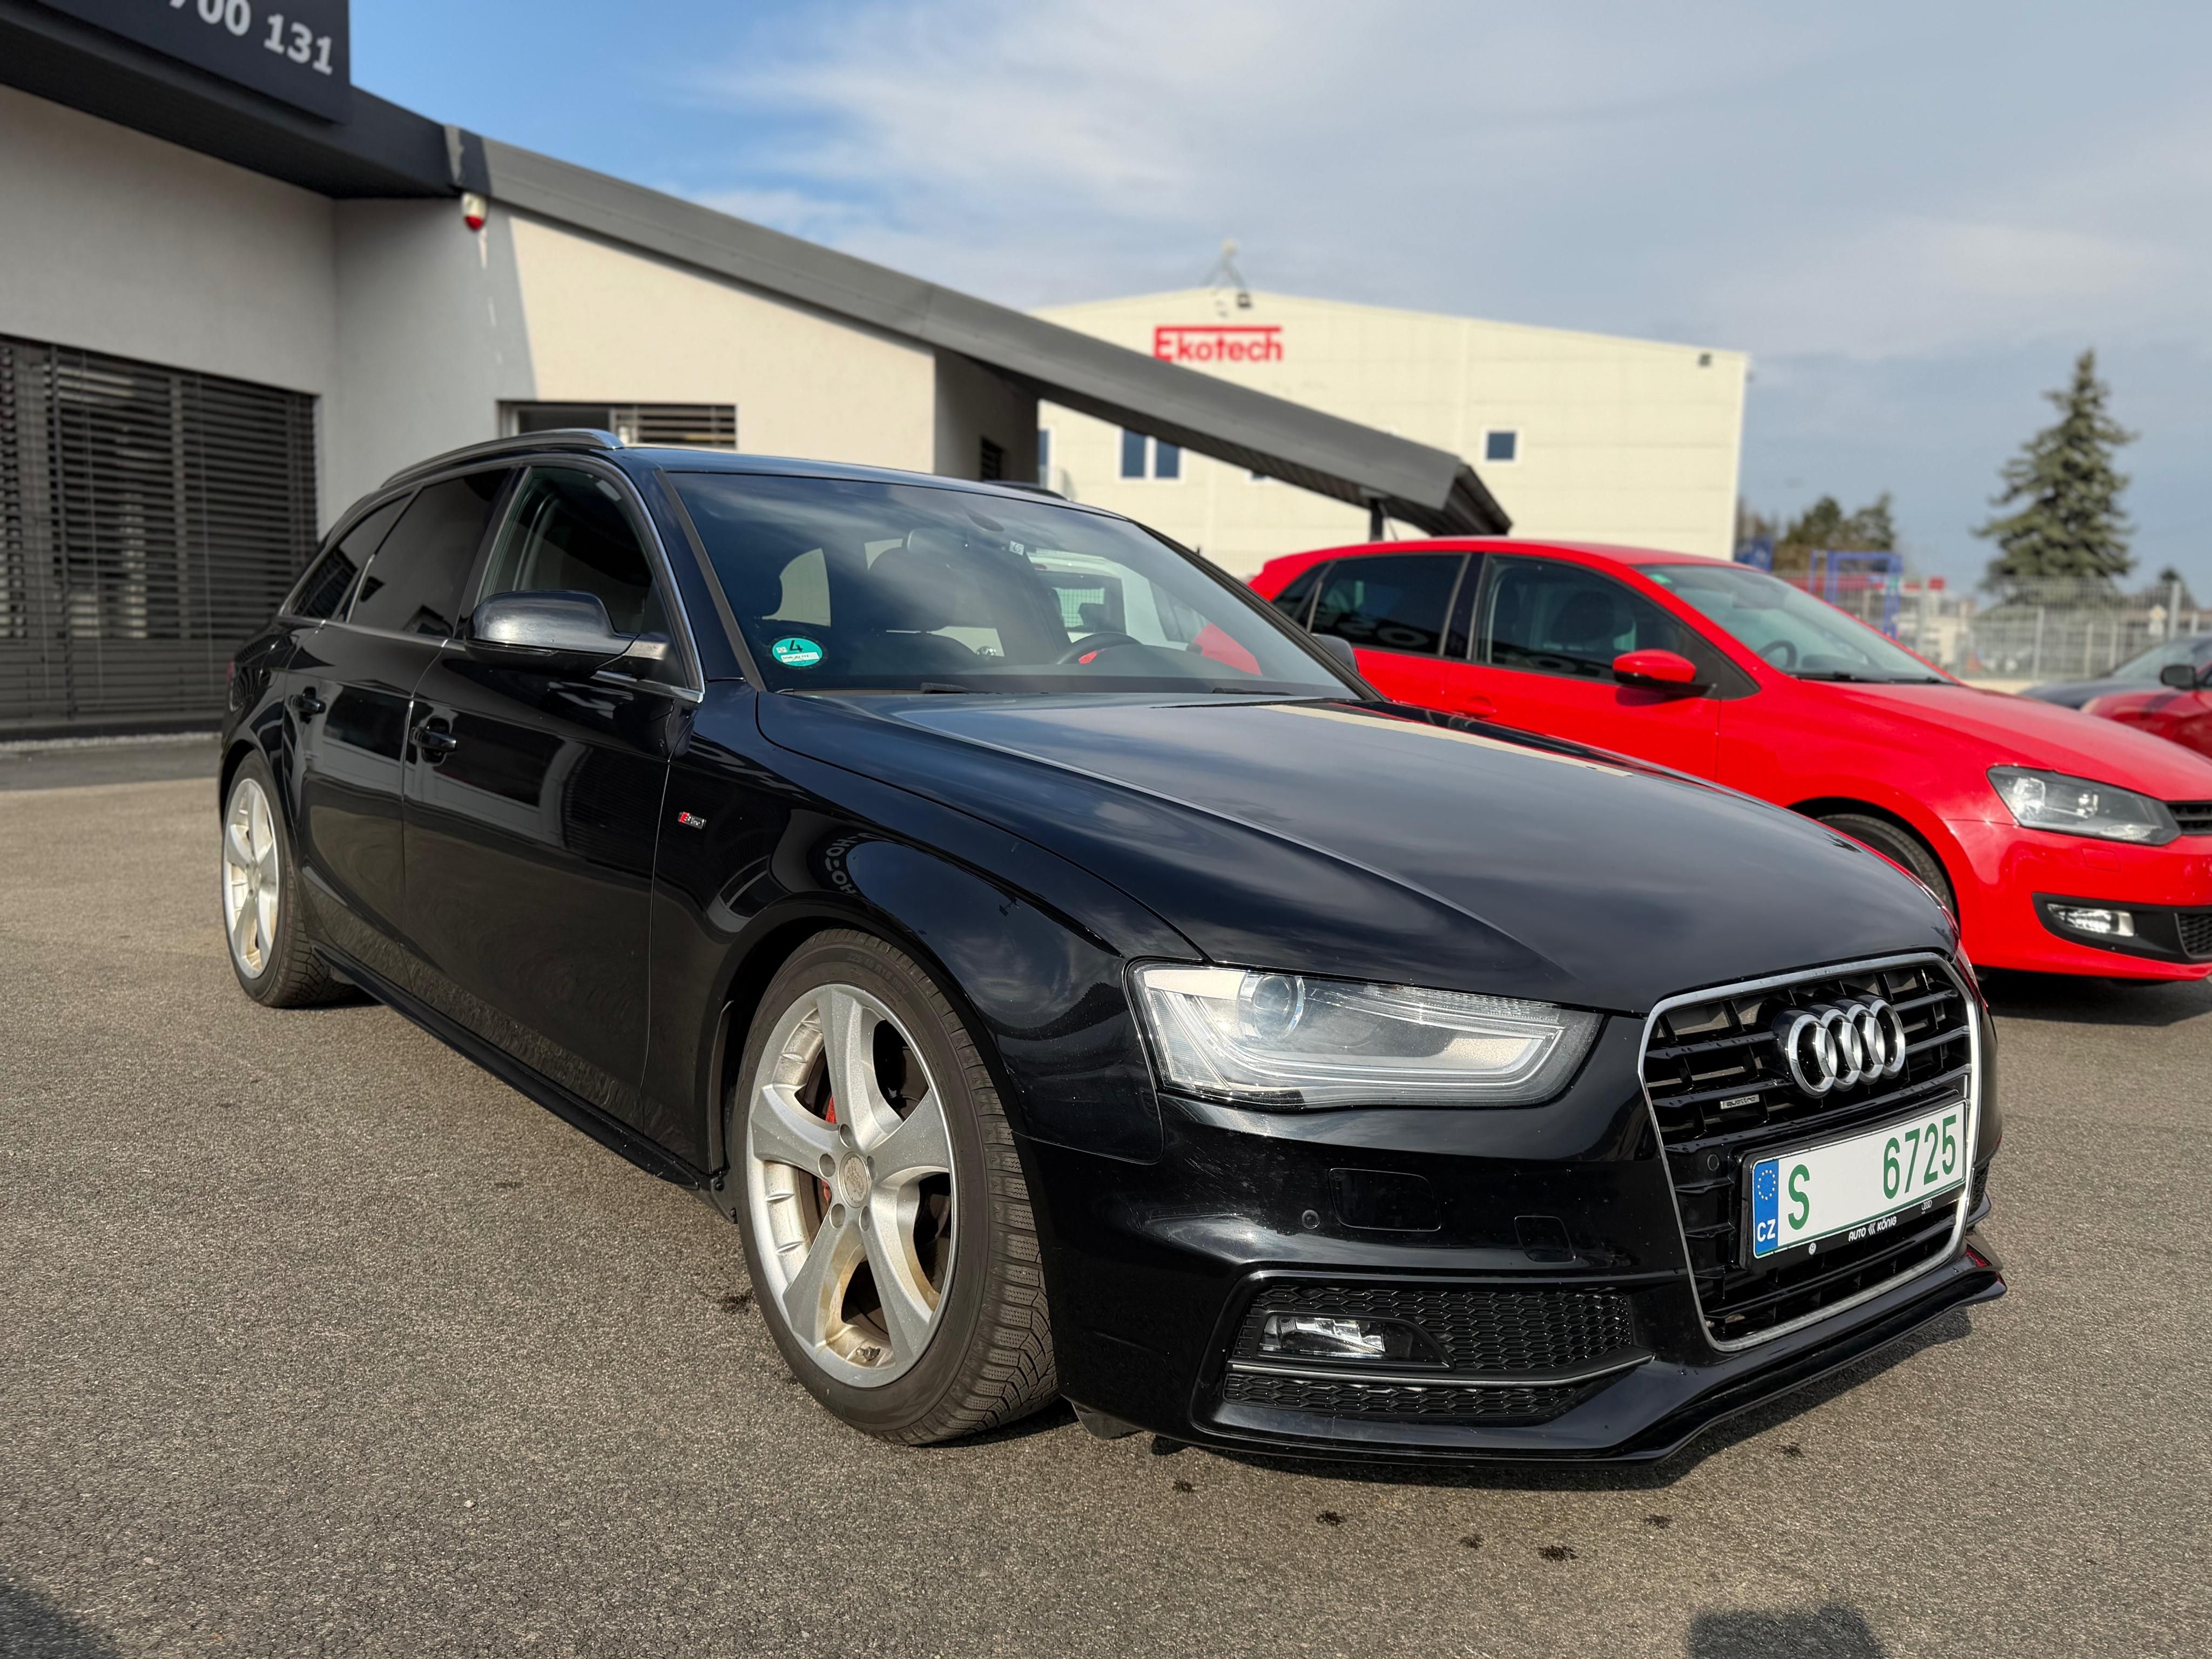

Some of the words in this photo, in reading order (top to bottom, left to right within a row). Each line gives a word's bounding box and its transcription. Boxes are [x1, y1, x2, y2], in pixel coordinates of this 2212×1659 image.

[264, 14, 333, 76] 131
[1154, 326, 1283, 362] Ekotech
[789, 639, 803, 652] 4
[1788, 1164, 1810, 1231] S
[1883, 1114, 1957, 1200] 6725
[1757, 1218, 1776, 1243] CZ
[1848, 1227, 1866, 1242] AUTO
[1877, 1216, 1897, 1232] KÖNIG
